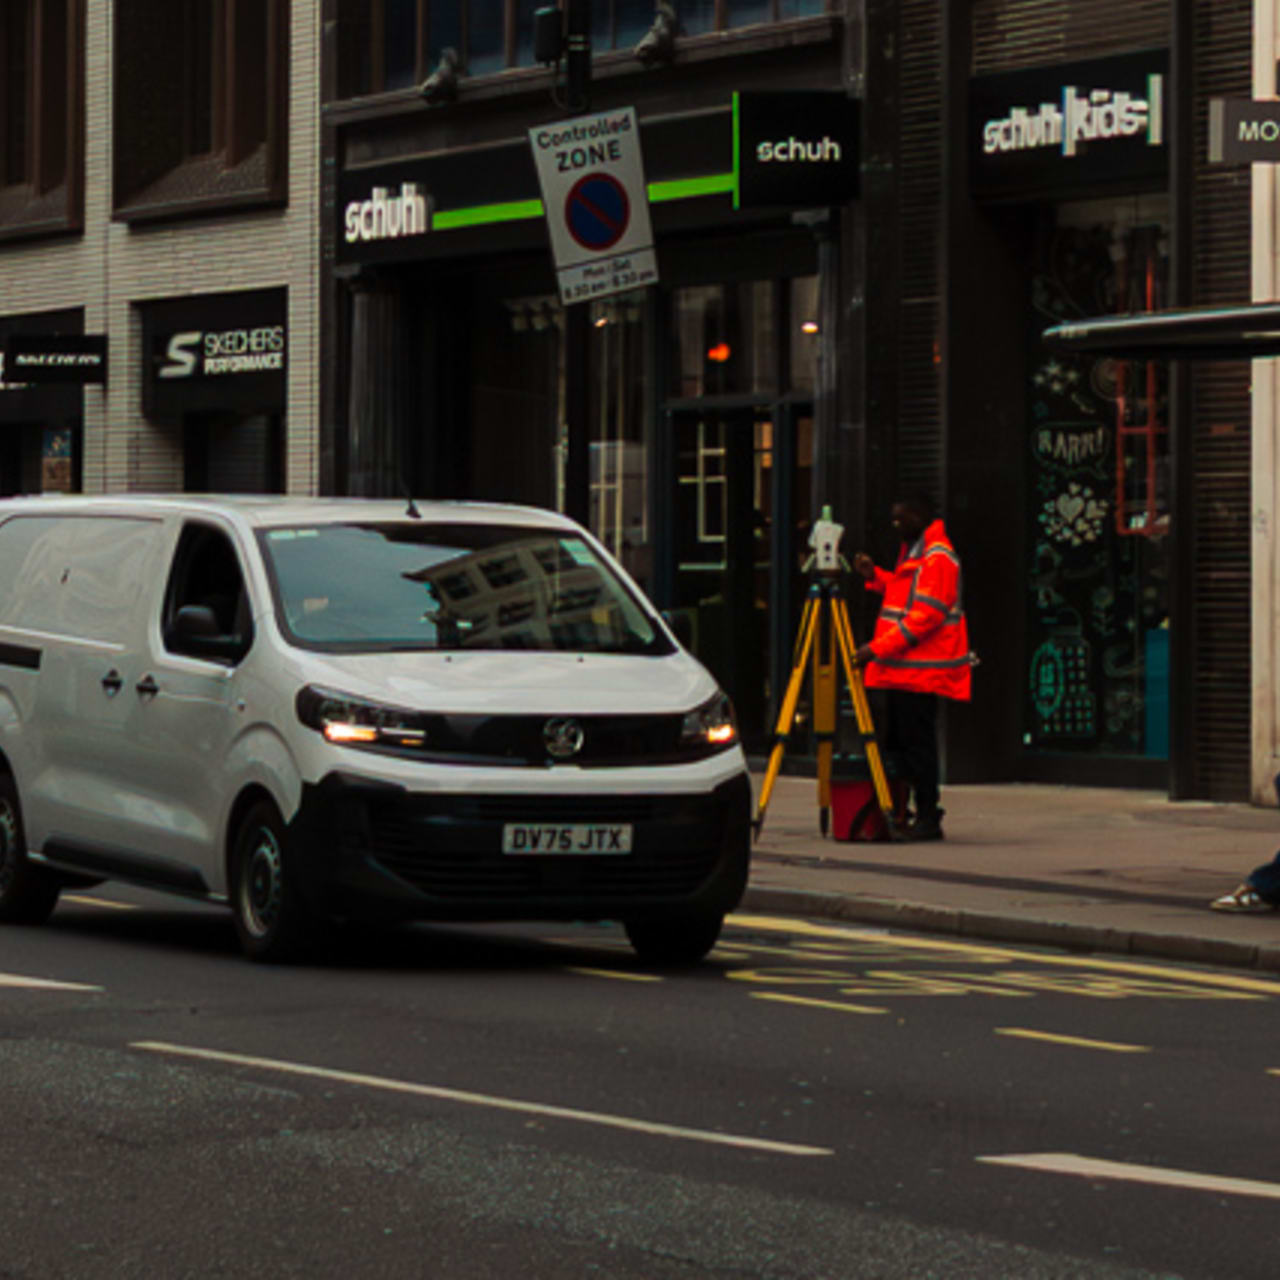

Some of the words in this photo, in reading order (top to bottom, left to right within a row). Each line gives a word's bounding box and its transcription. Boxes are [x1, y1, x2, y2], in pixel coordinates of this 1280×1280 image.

[536, 115, 632, 149] Controlled
[983, 103, 1063, 153] schuh
[1074, 90, 1148, 140] kids
[556, 139, 622, 172] ZONE
[757, 136, 841, 161] schuh
[345, 182, 428, 242] schuh
[204, 326, 284, 356] SKECHERS
[204, 351, 284, 375] PERFORMANCE
[512, 827, 573, 850] DV75
[577, 827, 622, 851] JTX
